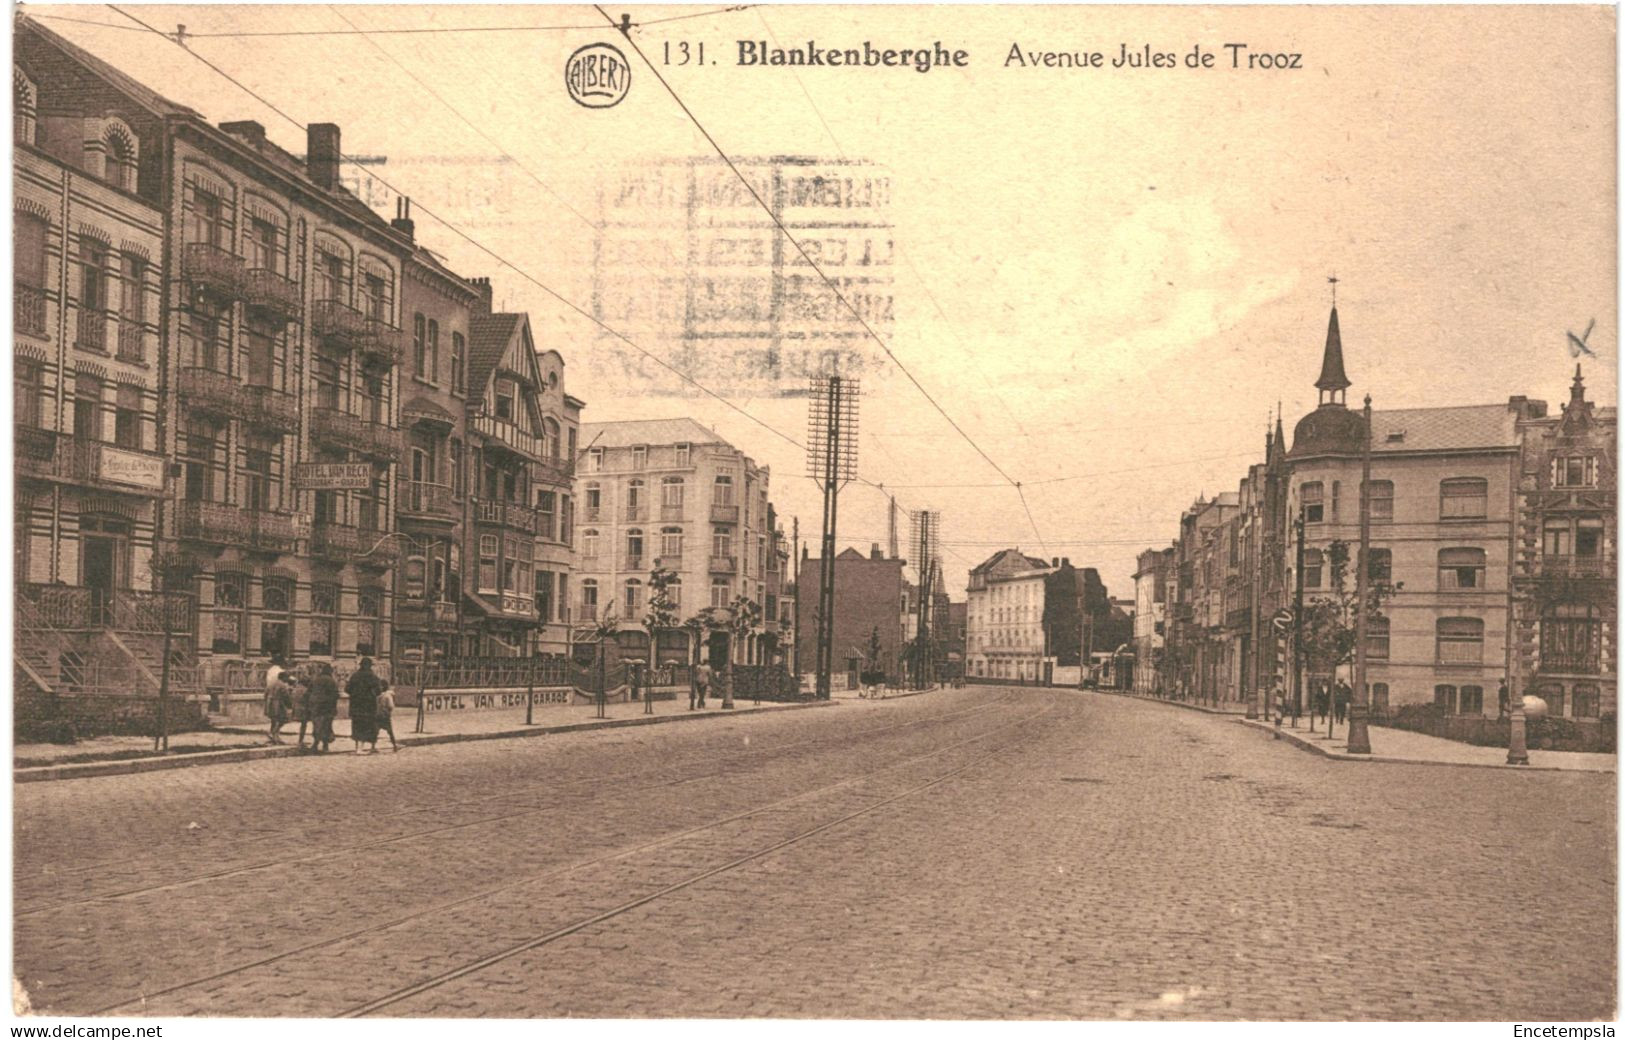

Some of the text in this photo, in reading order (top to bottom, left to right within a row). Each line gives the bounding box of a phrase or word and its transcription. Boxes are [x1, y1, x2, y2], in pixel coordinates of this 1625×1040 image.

[662, 39, 1304, 74] 131. Blankenberghe Avenue Jules de Trooz
[569, 53, 629, 97] ALBERT
[297, 463, 327, 479] HOTEL
[328, 463, 345, 479] VAN
[426, 691, 568, 712] HOTEL VAN RECK GARAGE
